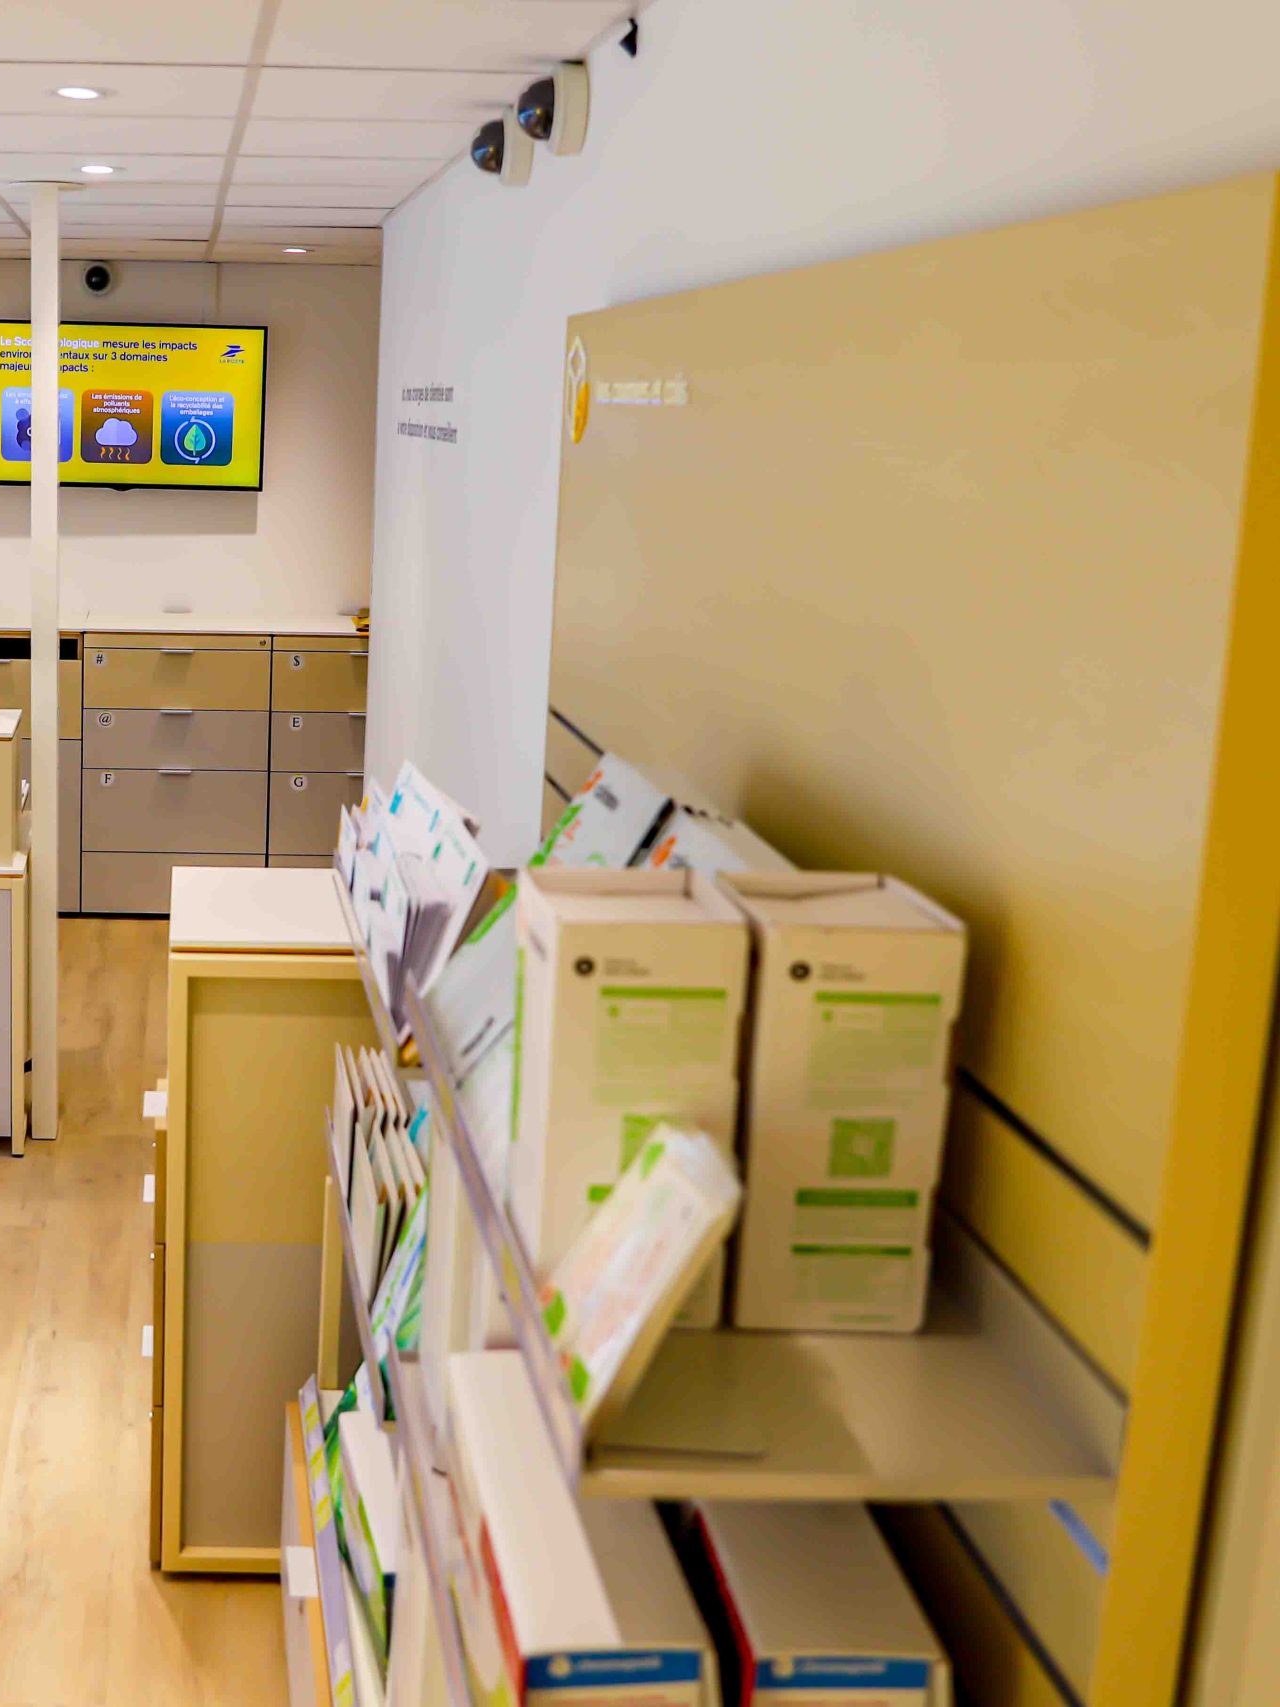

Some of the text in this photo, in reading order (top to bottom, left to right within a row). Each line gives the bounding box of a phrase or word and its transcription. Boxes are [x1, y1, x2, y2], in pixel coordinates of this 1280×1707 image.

[0, 336, 12, 347] Le
[102, 340, 139, 349] mesure
[142, 340, 156, 350] les
[159, 340, 198, 352] impacts
[93, 352, 107, 360] sur
[111, 351, 117, 361] 3
[119, 352, 168, 362] domaines
[103, 393, 133, 401] émissions
[92, 407, 141, 415] atmosphériques
[96, 654, 103, 664] #
[98, 712, 112, 727] @
[292, 717, 301, 728] E
[104, 773, 112, 784] F
[293, 776, 304, 788] G
